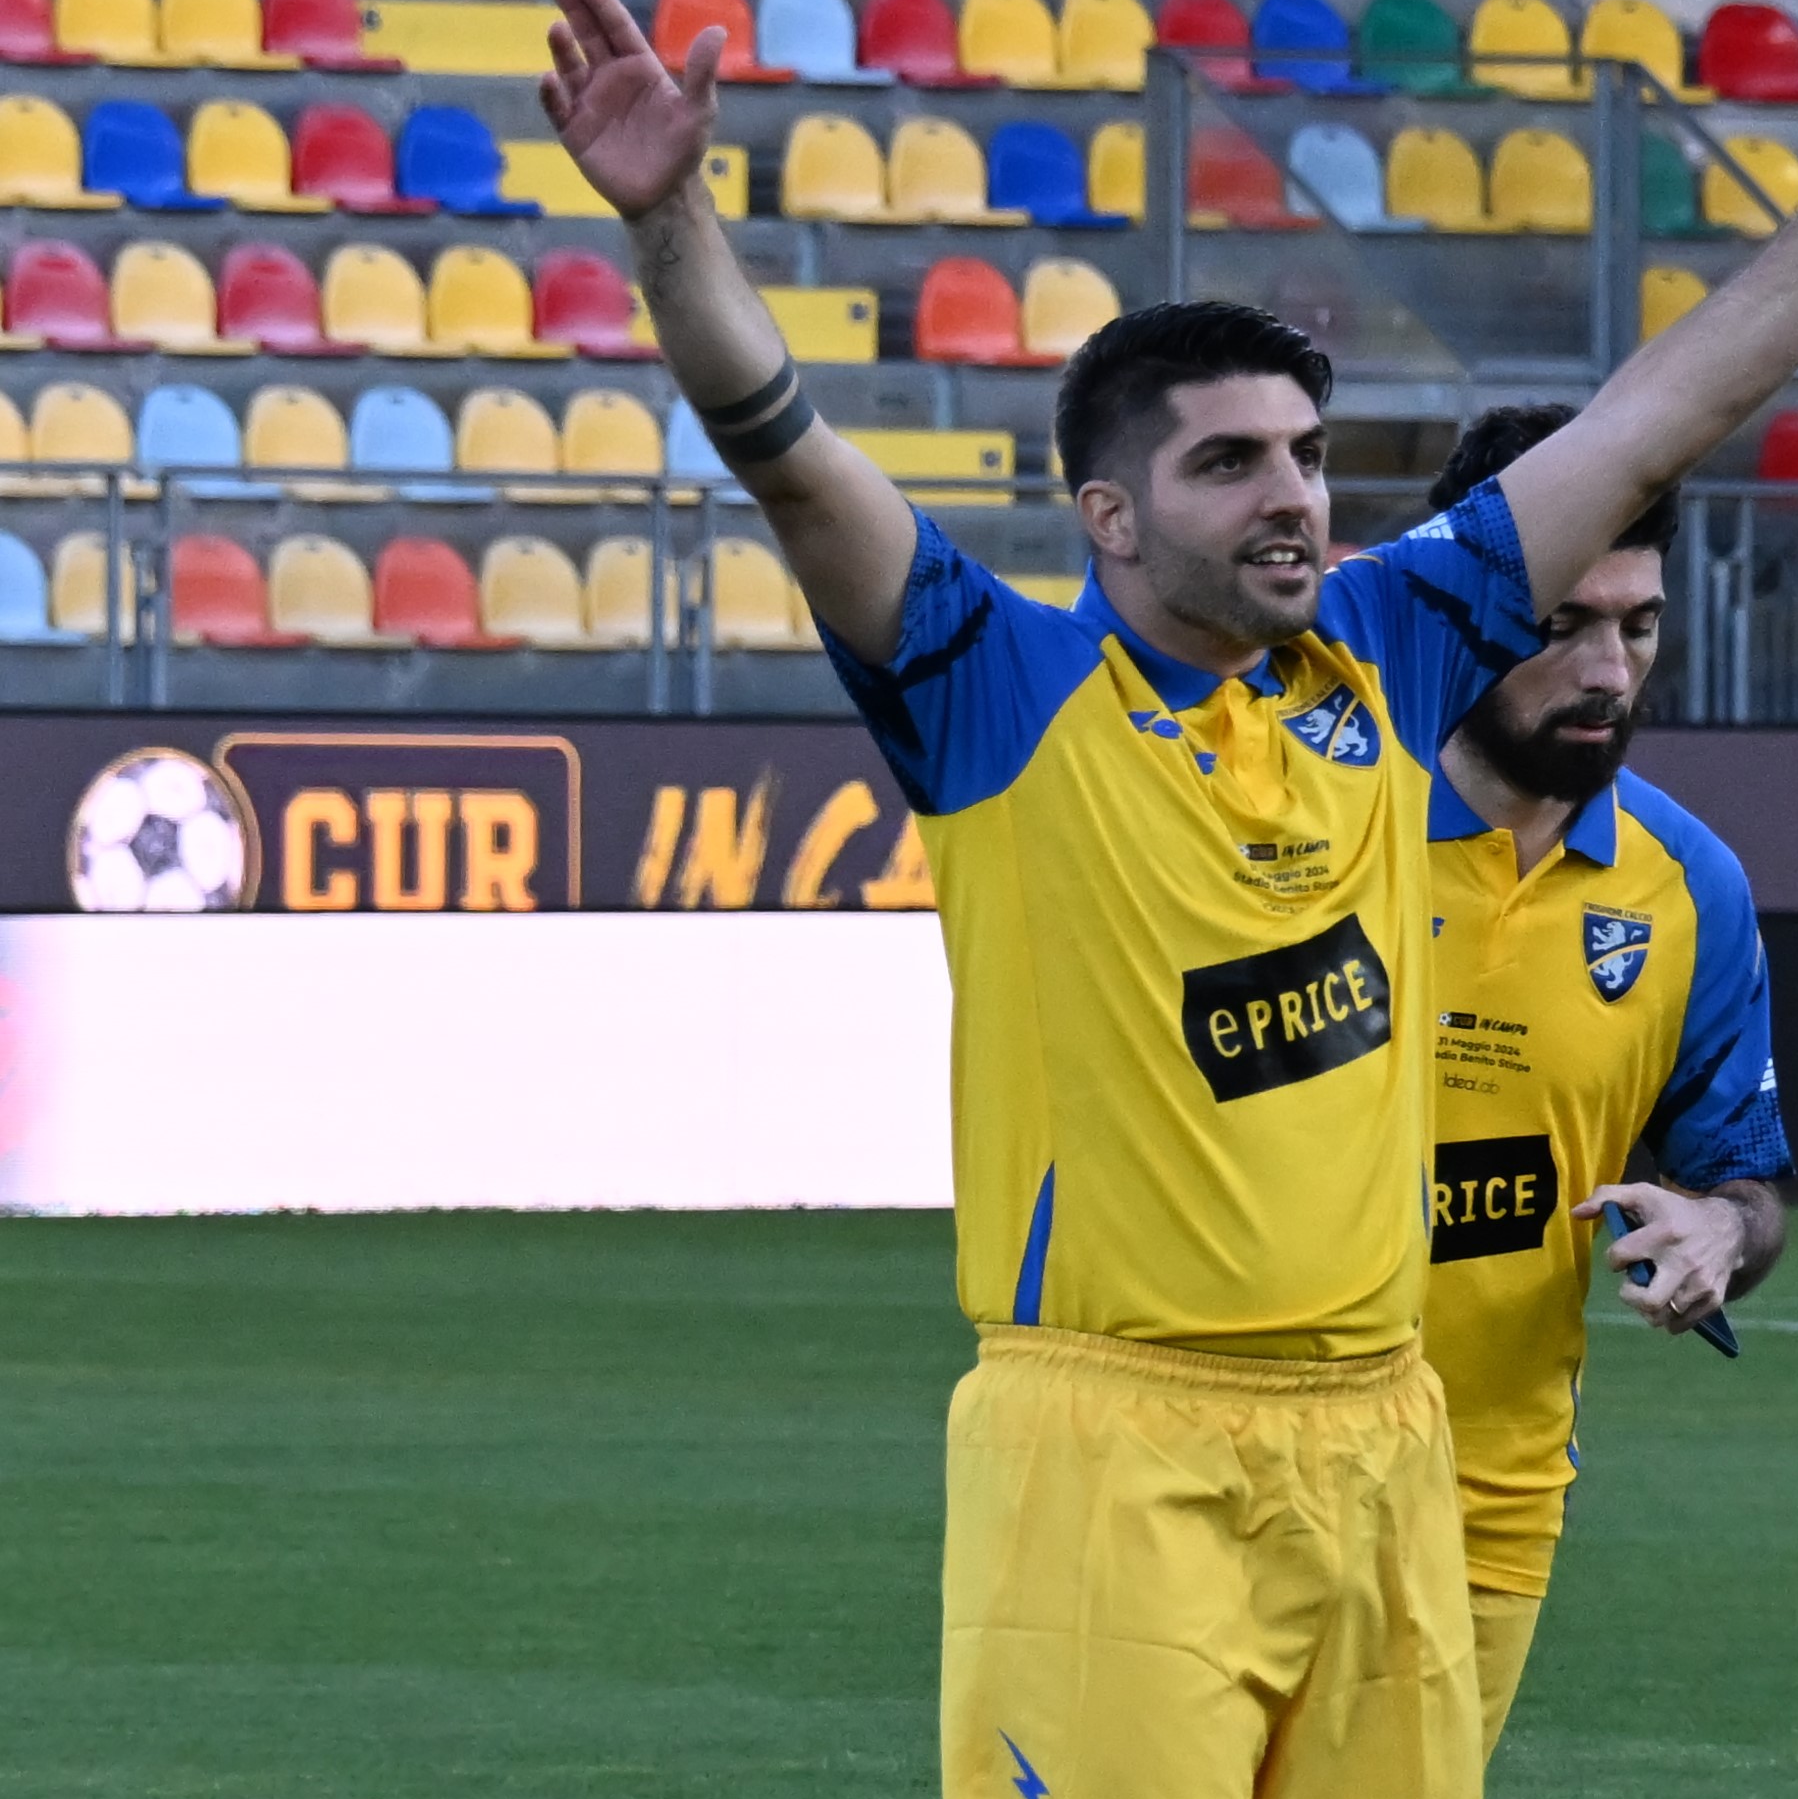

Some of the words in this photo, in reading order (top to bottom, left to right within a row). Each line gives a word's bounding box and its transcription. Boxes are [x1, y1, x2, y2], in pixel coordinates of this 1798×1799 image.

[282, 788, 539, 910] CUR
[636, 772, 776, 909] IN
[1208, 959, 1374, 1058] ePRICE
[1451, 1038, 1492, 1052] Maggio
[1494, 1043, 1521, 1057] 2024
[1460, 1052, 1496, 1066] Benito
[1498, 1059, 1532, 1073] Stirpe
[1432, 1173, 1537, 1227] RICE
